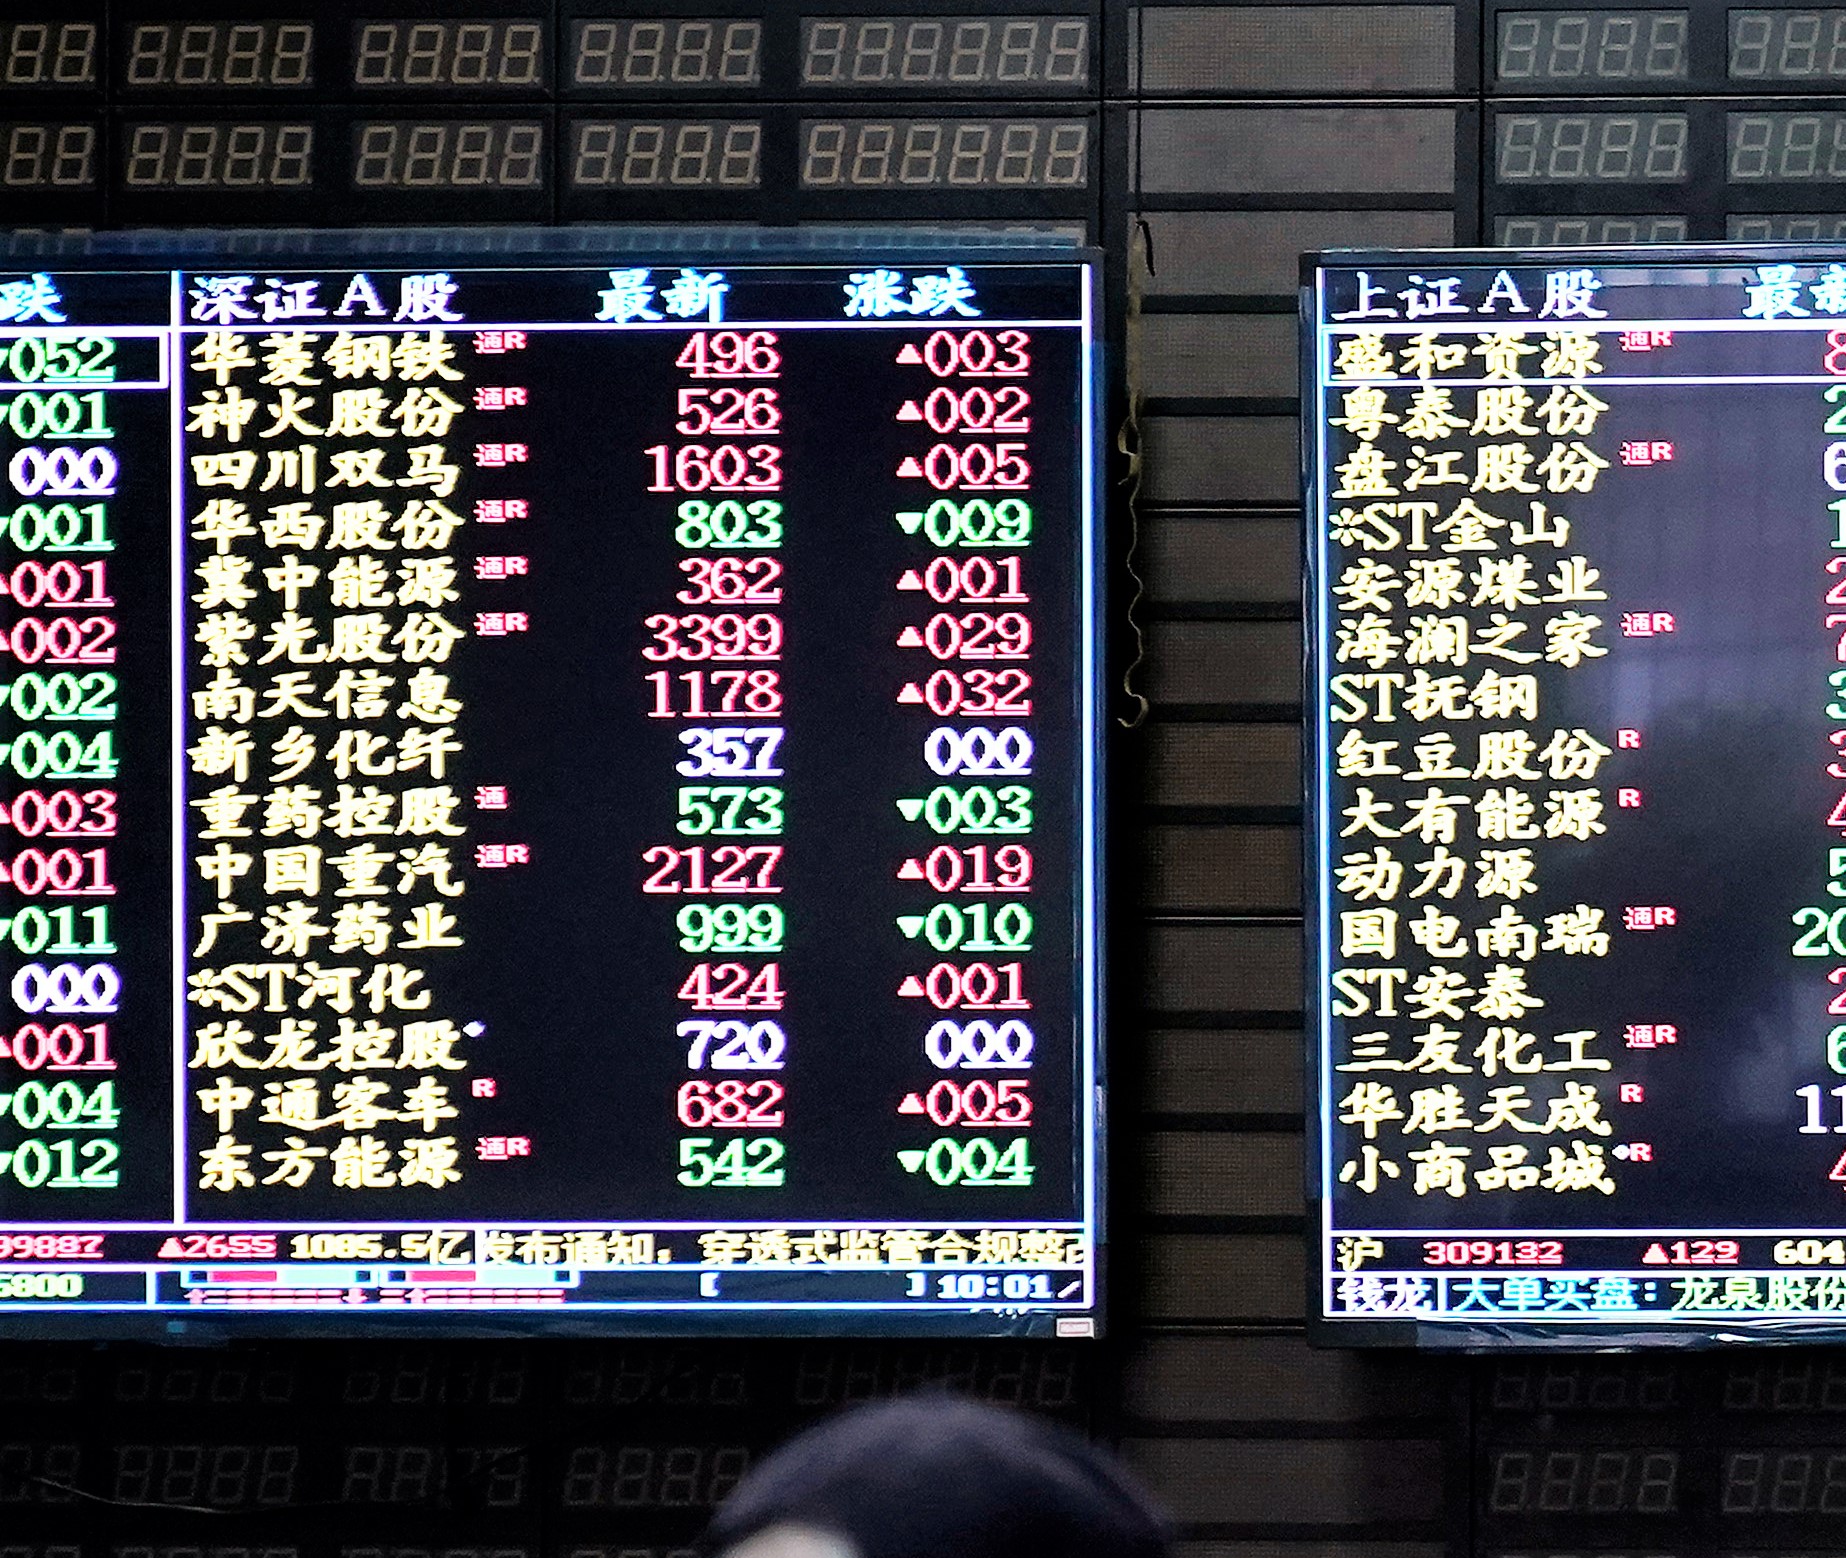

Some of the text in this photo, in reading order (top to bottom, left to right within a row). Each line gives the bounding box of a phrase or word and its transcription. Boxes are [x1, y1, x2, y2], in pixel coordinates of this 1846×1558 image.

[189, 266, 982, 325] 深证A股 最新 涨跌
[1330, 268, 1610, 320] 上证A股
[8, 337, 116, 383] 052
[190, 331, 465, 387] 华菱钢铁
[675, 331, 781, 379] 496
[923, 330, 1031, 377] 003
[1327, 331, 1612, 381] 盛和资源
[184, 386, 465, 442] 神火股份
[1327, 385, 1610, 442] 粤泰股份
[190, 443, 1031, 497] 四川双马 1603 005
[1331, 441, 1610, 499] 盘江股份
[191, 498, 466, 555] 华西股份
[191, 555, 460, 610] 冀中能源
[1332, 554, 1608, 612] 安源煤业
[194, 611, 466, 666] 紫光股份
[1327, 610, 1609, 670] 海澜之家
[191, 668, 1033, 724] 南天信息 1178 032
[1327, 668, 1538, 723] ST抚钢
[185, 725, 463, 783] 新乡化纤
[1327, 728, 1612, 781] 红豆股份
[189, 783, 467, 839] 重药控股
[1339, 786, 1607, 844] 大有能源
[195, 842, 465, 899] 中国重汽
[1333, 846, 1538, 901] 动力源
[10, 905, 117, 955] 011
[192, 900, 1033, 958] 广济药业 999 010
[1340, 903, 1610, 961] 国电南瑞
[1331, 963, 1544, 1021] ST安泰
[187, 1017, 468, 1072] 欣龙控股
[1335, 1022, 1612, 1078] 三友化工
[196, 1075, 459, 1133] 中通客车
[1338, 1081, 1612, 1139] 华胜天成
[11, 1139, 119, 1188] 012
[199, 1134, 462, 1192] 东方能源
[677, 1137, 785, 1187] 542
[923, 1137, 1036, 1186] 004
[1338, 1140, 1614, 1197] 小商品城
[185, 1235, 277, 1259] 2655
[289, 1232, 472, 1264] 1085.5亿
[1337, 1236, 1384, 1271] 沪
[1423, 1240, 1564, 1267] 309132
[1670, 1240, 1740, 1266] 129
[937, 1274, 1054, 1299] 10:01
